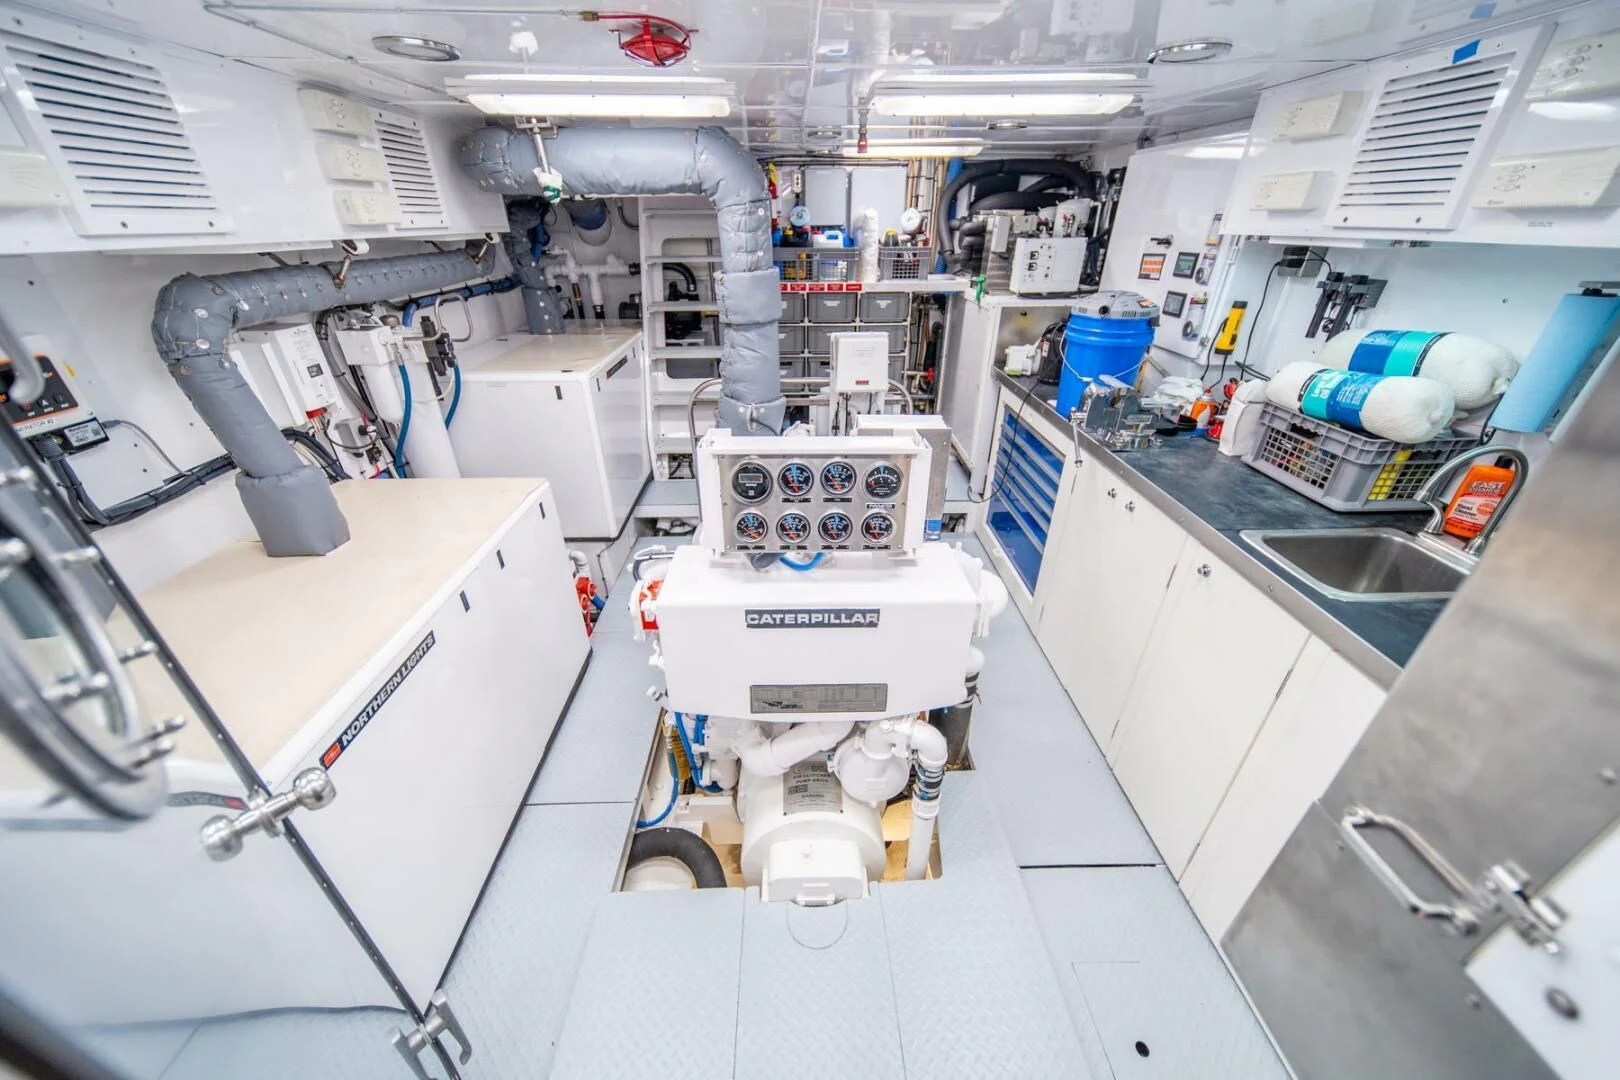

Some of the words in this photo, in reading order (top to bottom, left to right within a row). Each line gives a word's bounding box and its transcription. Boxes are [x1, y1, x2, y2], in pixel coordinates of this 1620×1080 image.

[1471, 480, 1506, 489] FAST
[745, 613, 879, 624] CATERPILLAR
[341, 671, 402, 746] NORTHERN
[400, 635, 434, 677] LIGHTS
